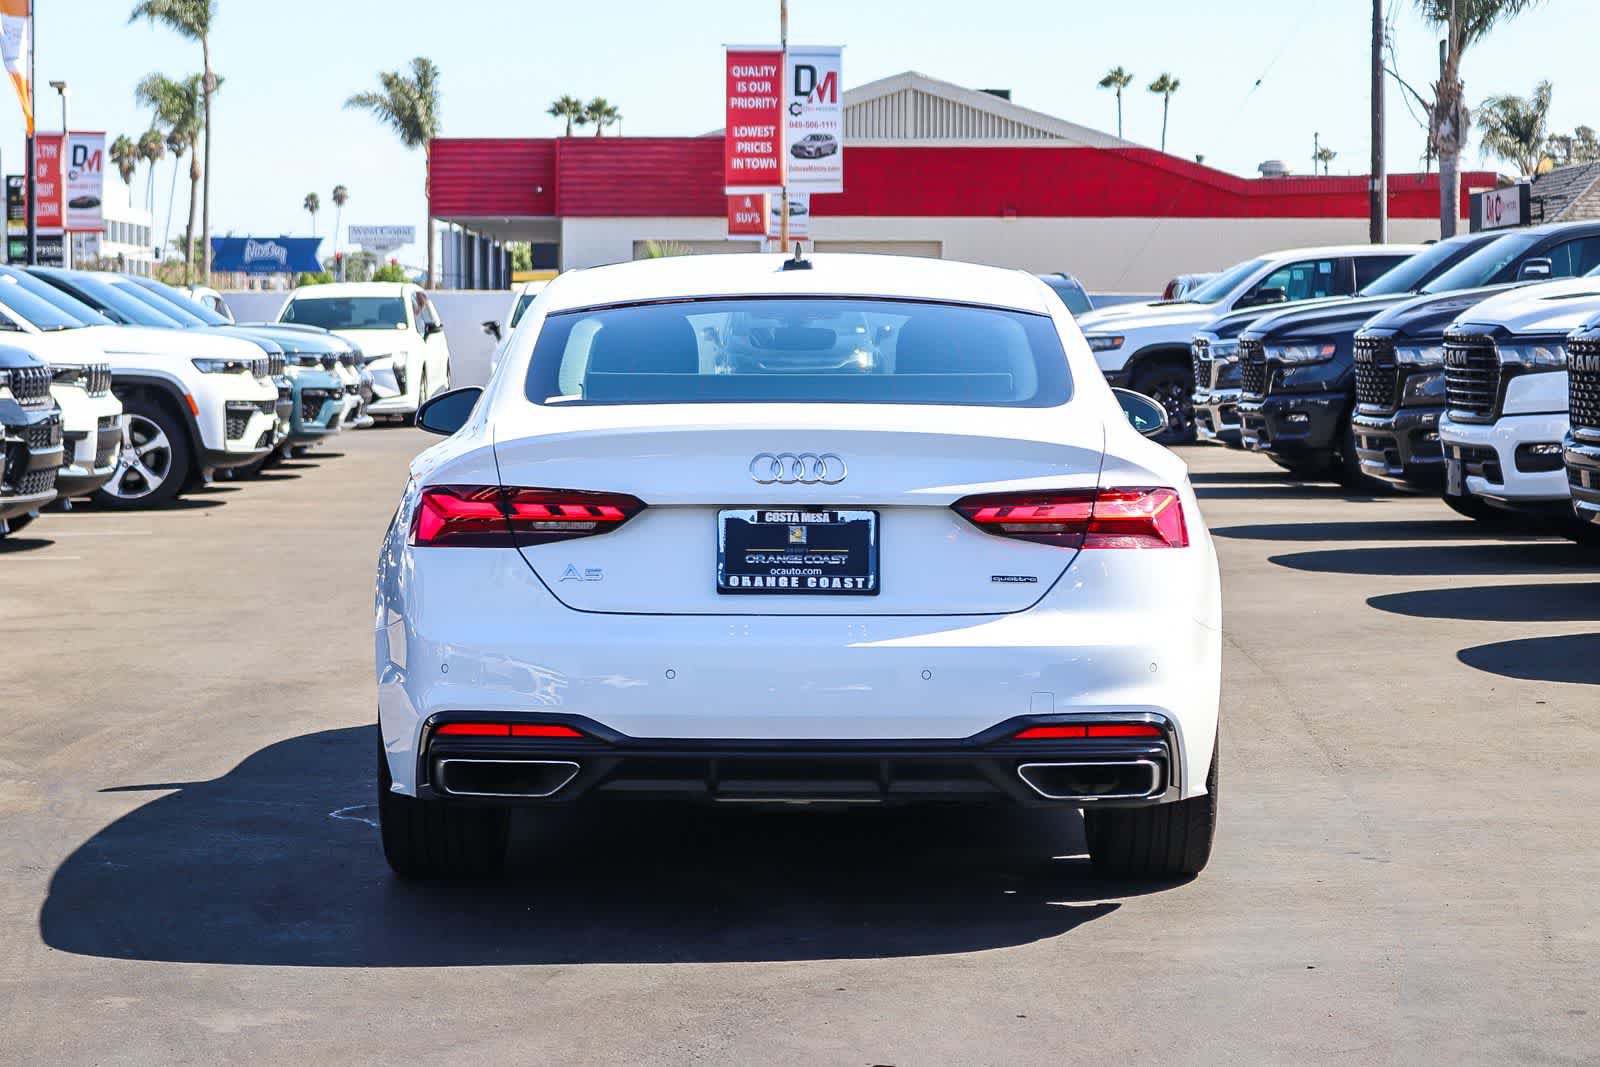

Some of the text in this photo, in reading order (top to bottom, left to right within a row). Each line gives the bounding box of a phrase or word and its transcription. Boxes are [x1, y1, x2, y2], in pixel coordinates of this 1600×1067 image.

[732, 65, 777, 78] QUALITY
[736, 81, 772, 93] IS OUR
[731, 96, 778, 109] PRIORITY
[733, 126, 776, 138] LOWEST
[736, 142, 772, 153] PRICES
[732, 157, 744, 169] IN
[744, 157, 777, 169] TOWN
[1568, 354, 1600, 371] RAM
[765, 511, 830, 523] COSTA MESA
[745, 554, 848, 565] ORANGE COAST
[560, 563, 604, 582] A5
[770, 567, 822, 575] ocauto.com
[729, 575, 865, 589] ORANGE COAST
[992, 575, 1038, 583] quattro
